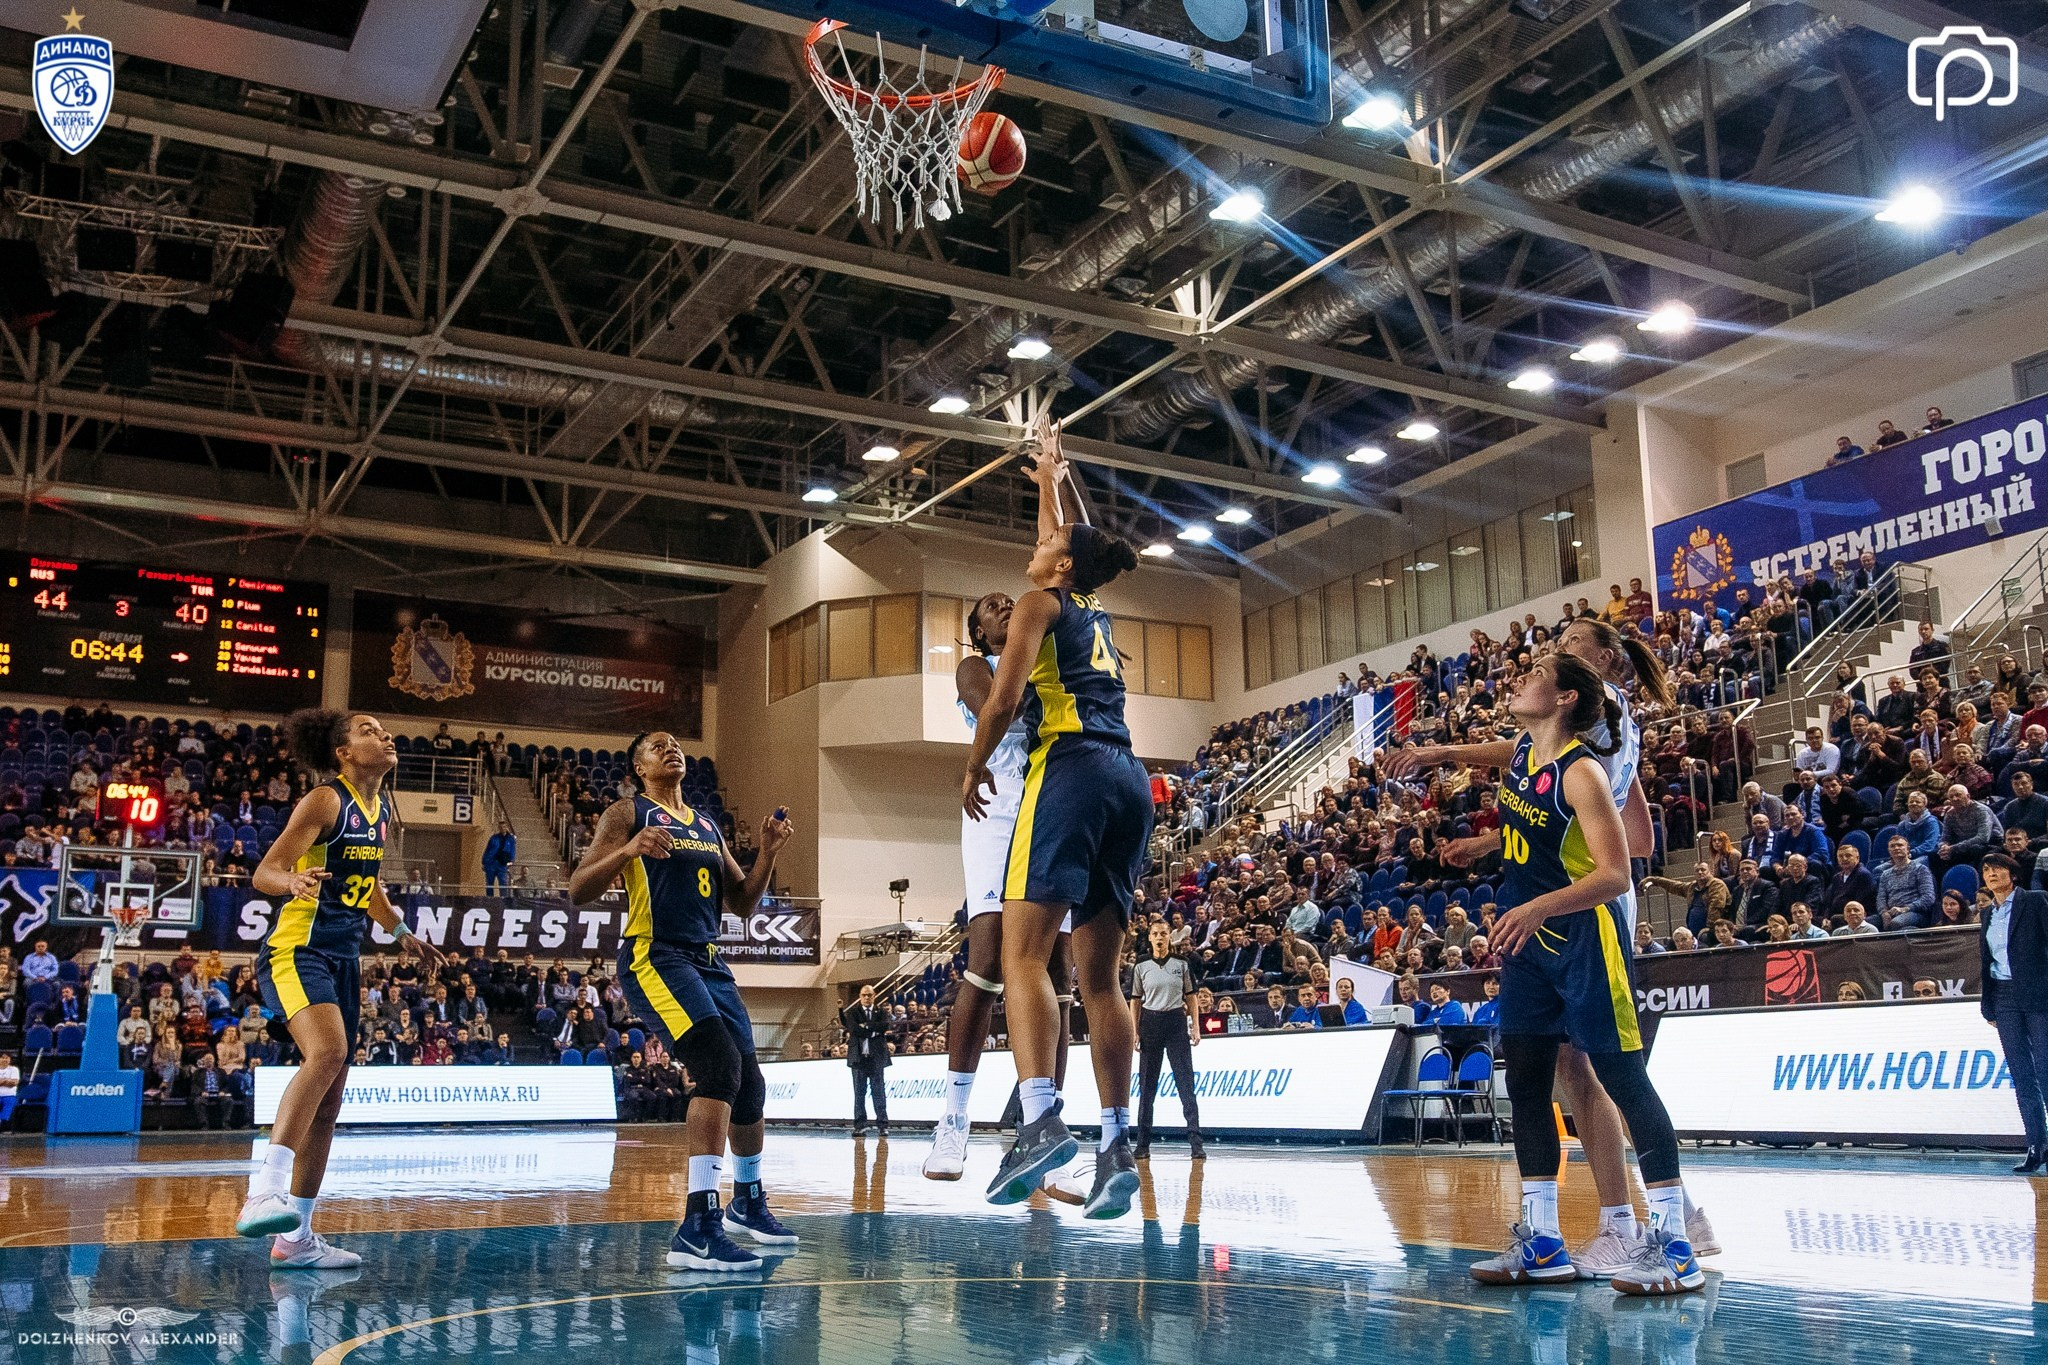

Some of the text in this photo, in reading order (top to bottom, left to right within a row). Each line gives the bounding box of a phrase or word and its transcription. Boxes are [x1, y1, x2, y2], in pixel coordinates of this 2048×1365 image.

[1921, 414, 2048, 495] ГОРО
[1750, 472, 2035, 587] УСТРЕМЛЕННЫЙ
[30, 568, 55, 580] RUS
[138, 569, 213, 585] Fenerbahce
[34, 590, 68, 611] 44
[190, 585, 214, 597] TUR
[115, 600, 129, 616] 3
[175, 603, 208, 624] 40
[221, 598, 234, 608] 10
[296, 606, 302, 615] 1
[307, 607, 318, 617] 11
[221, 619, 233, 629] 12
[311, 628, 319, 637] 2
[0, 654, 11, 664] 0
[70, 638, 144, 663] 06:44
[1089, 620, 1118, 679] 4
[0, 665, 10, 675] 4
[216, 661, 229, 671] 24
[291, 668, 300, 678] 2
[485, 651, 603, 672] АДМИНИСТРАЦИЯ
[485, 665, 665, 694] КУРСКОЙ ОБЛАСТИ
[130, 798, 158, 822] 10
[1503, 824, 1529, 864] 10
[341, 874, 376, 909] 32
[697, 867, 711, 898] 8
[713, 944, 814, 956] ОНЦЕРТНЫЙ КОМПЛЕКС
[70, 1083, 124, 1096] molten
[342, 1086, 540, 1104] WWW.HOLIDAYMAX.RU
